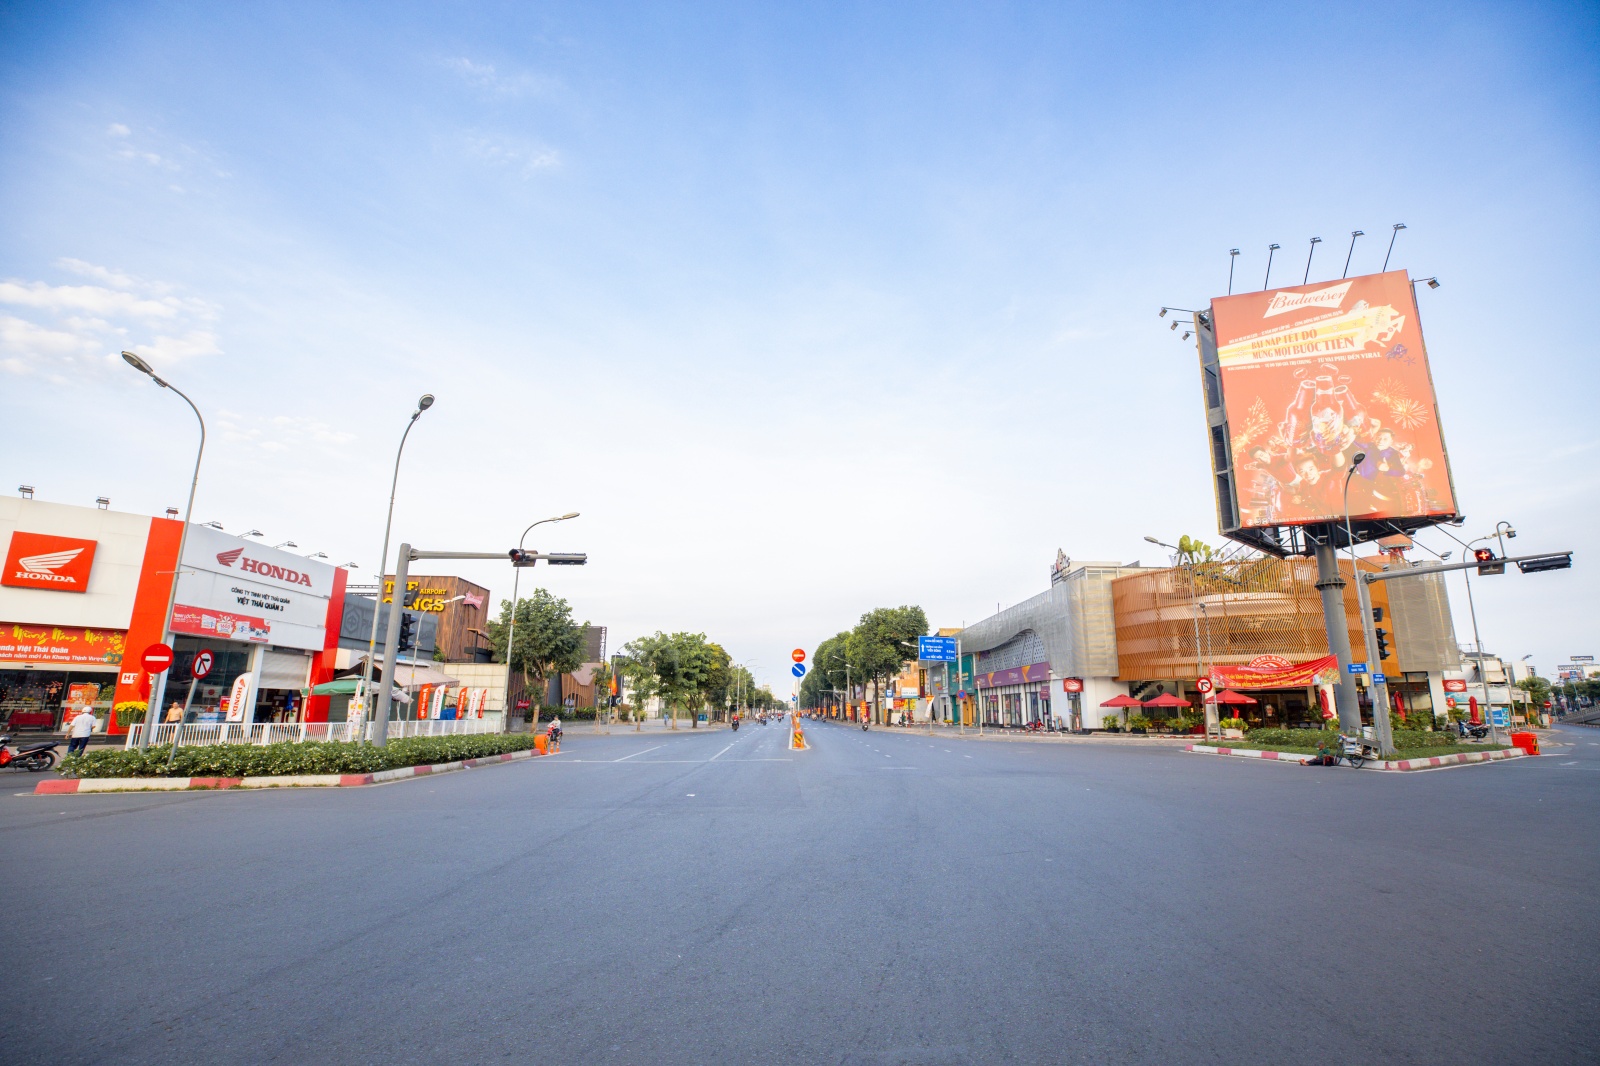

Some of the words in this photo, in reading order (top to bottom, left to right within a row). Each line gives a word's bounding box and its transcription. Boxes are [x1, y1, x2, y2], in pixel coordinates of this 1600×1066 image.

[1267, 291, 1346, 309] Budweiser
[15, 572, 76, 583] HONDA
[240, 557, 312, 587] HONDA
[384, 580, 418, 594] TE
[237, 597, 250, 605] VIỆT
[252, 599, 264, 608] THÁI
[17, 645, 32, 653] Việt
[232, 687, 242, 717] HONDA
